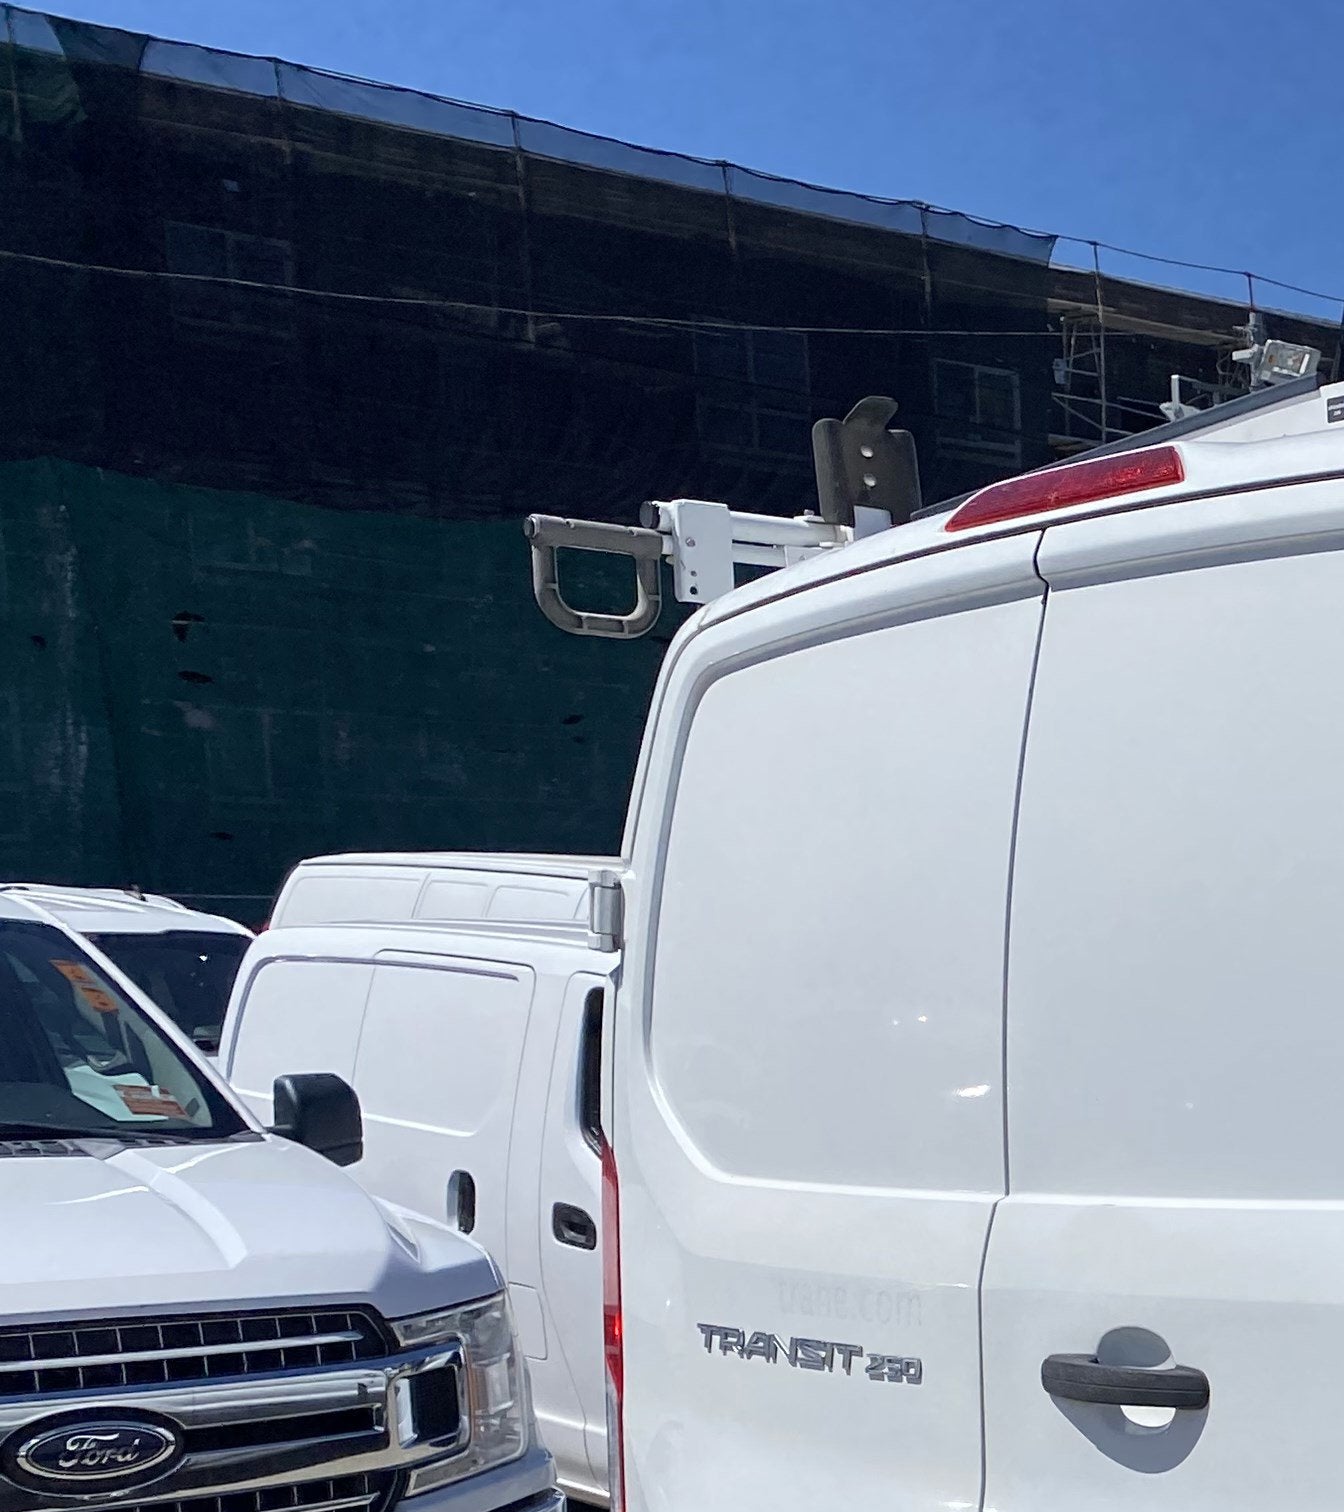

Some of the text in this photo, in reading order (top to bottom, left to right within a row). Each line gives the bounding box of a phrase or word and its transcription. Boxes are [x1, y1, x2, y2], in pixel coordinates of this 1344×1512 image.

[696, 1322, 924, 1386] TRANSIT 250
[57, 1432, 141, 1468] Ford
